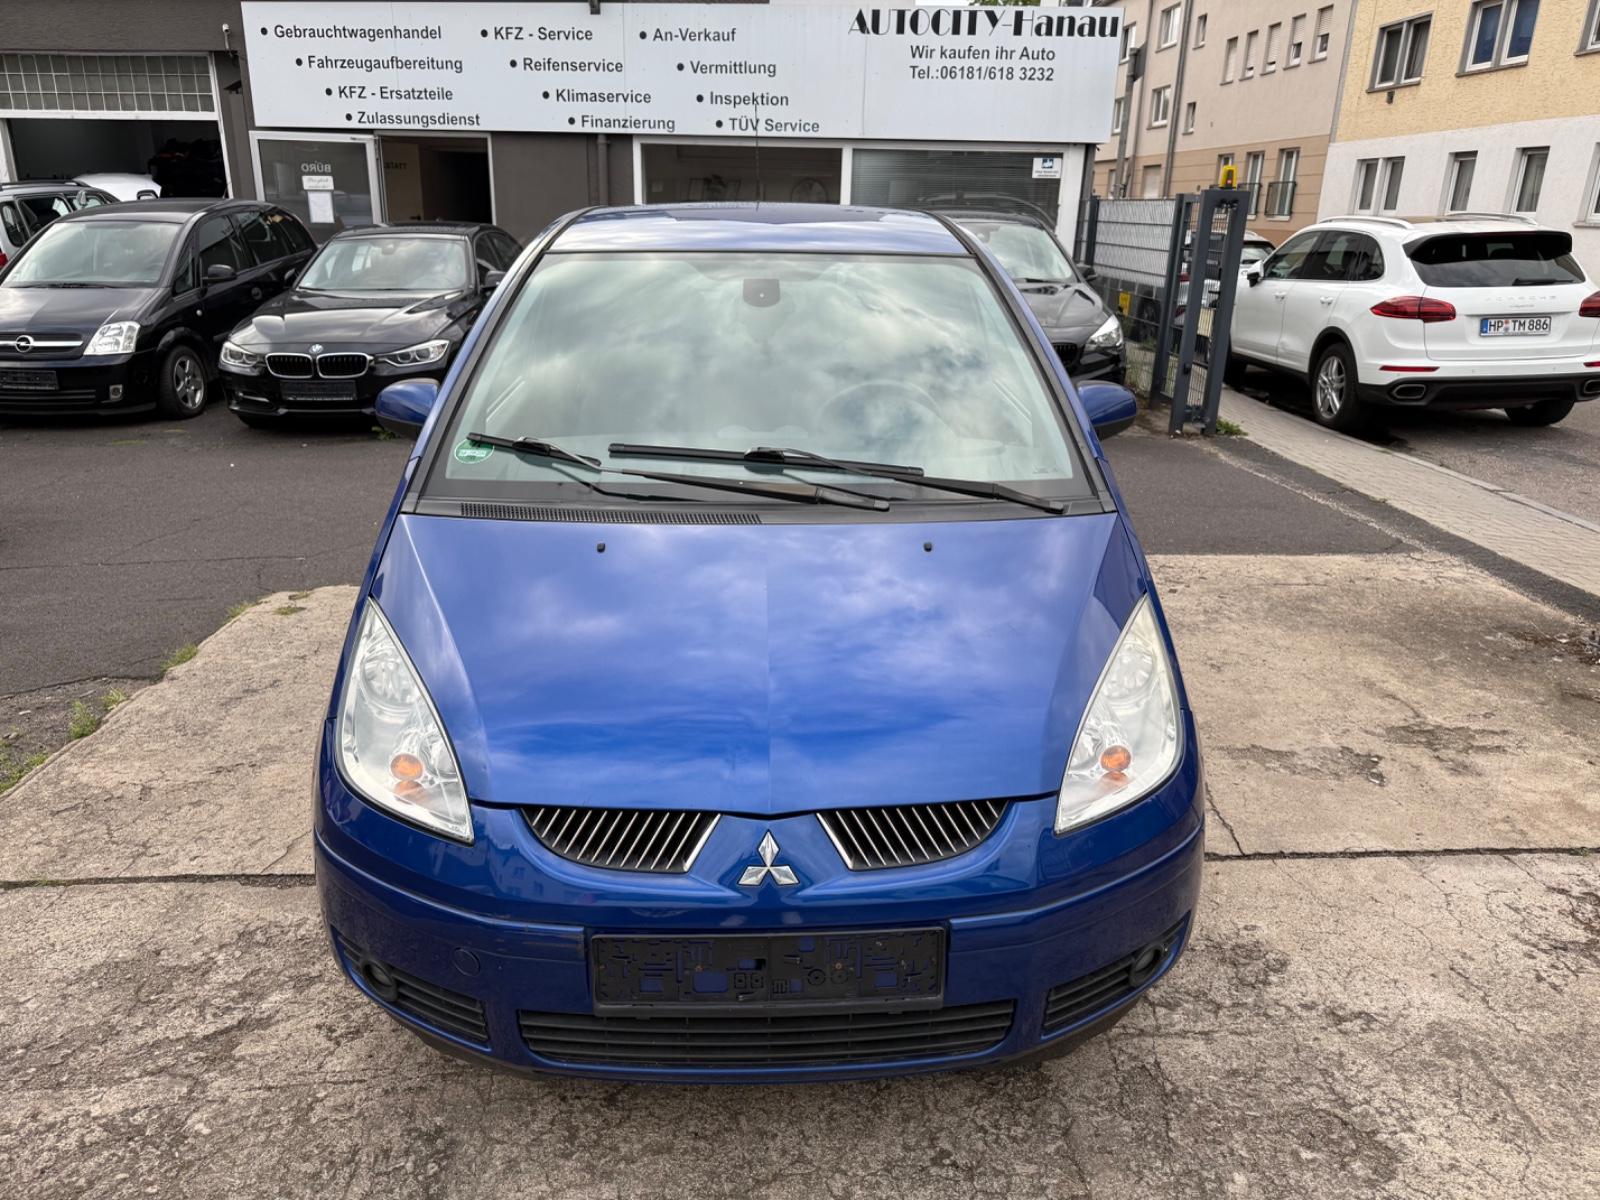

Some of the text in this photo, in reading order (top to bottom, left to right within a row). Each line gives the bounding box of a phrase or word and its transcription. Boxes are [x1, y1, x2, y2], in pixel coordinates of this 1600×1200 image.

[849, 8, 1119, 38] AUTOCITY-Hanau
[274, 25, 442, 42] Gebrauchtwagenhandel
[494, 27, 524, 40] KFZ
[538, 27, 593, 41] Service
[653, 28, 737, 42] An-Verkauf
[911, 45, 1056, 61] Wir kaufen ihr Auto
[307, 56, 463, 73] Fahrzeugaufbereitung
[523, 58, 623, 73] Reifenservice
[690, 60, 777, 77] Vermittlung
[1019, 67, 1055, 81] 3232
[338, 86, 367, 100] KFZ
[380, 86, 453, 101] Ersatzteile
[556, 89, 651, 104] Klimaservice
[710, 92, 789, 107] Inspektion
[358, 111, 480, 128] Zulassungsdienst
[581, 115, 676, 131] Finanzierung
[729, 116, 820, 133] TÜV Service
[1489, 319, 1548, 332] HP TM 886
